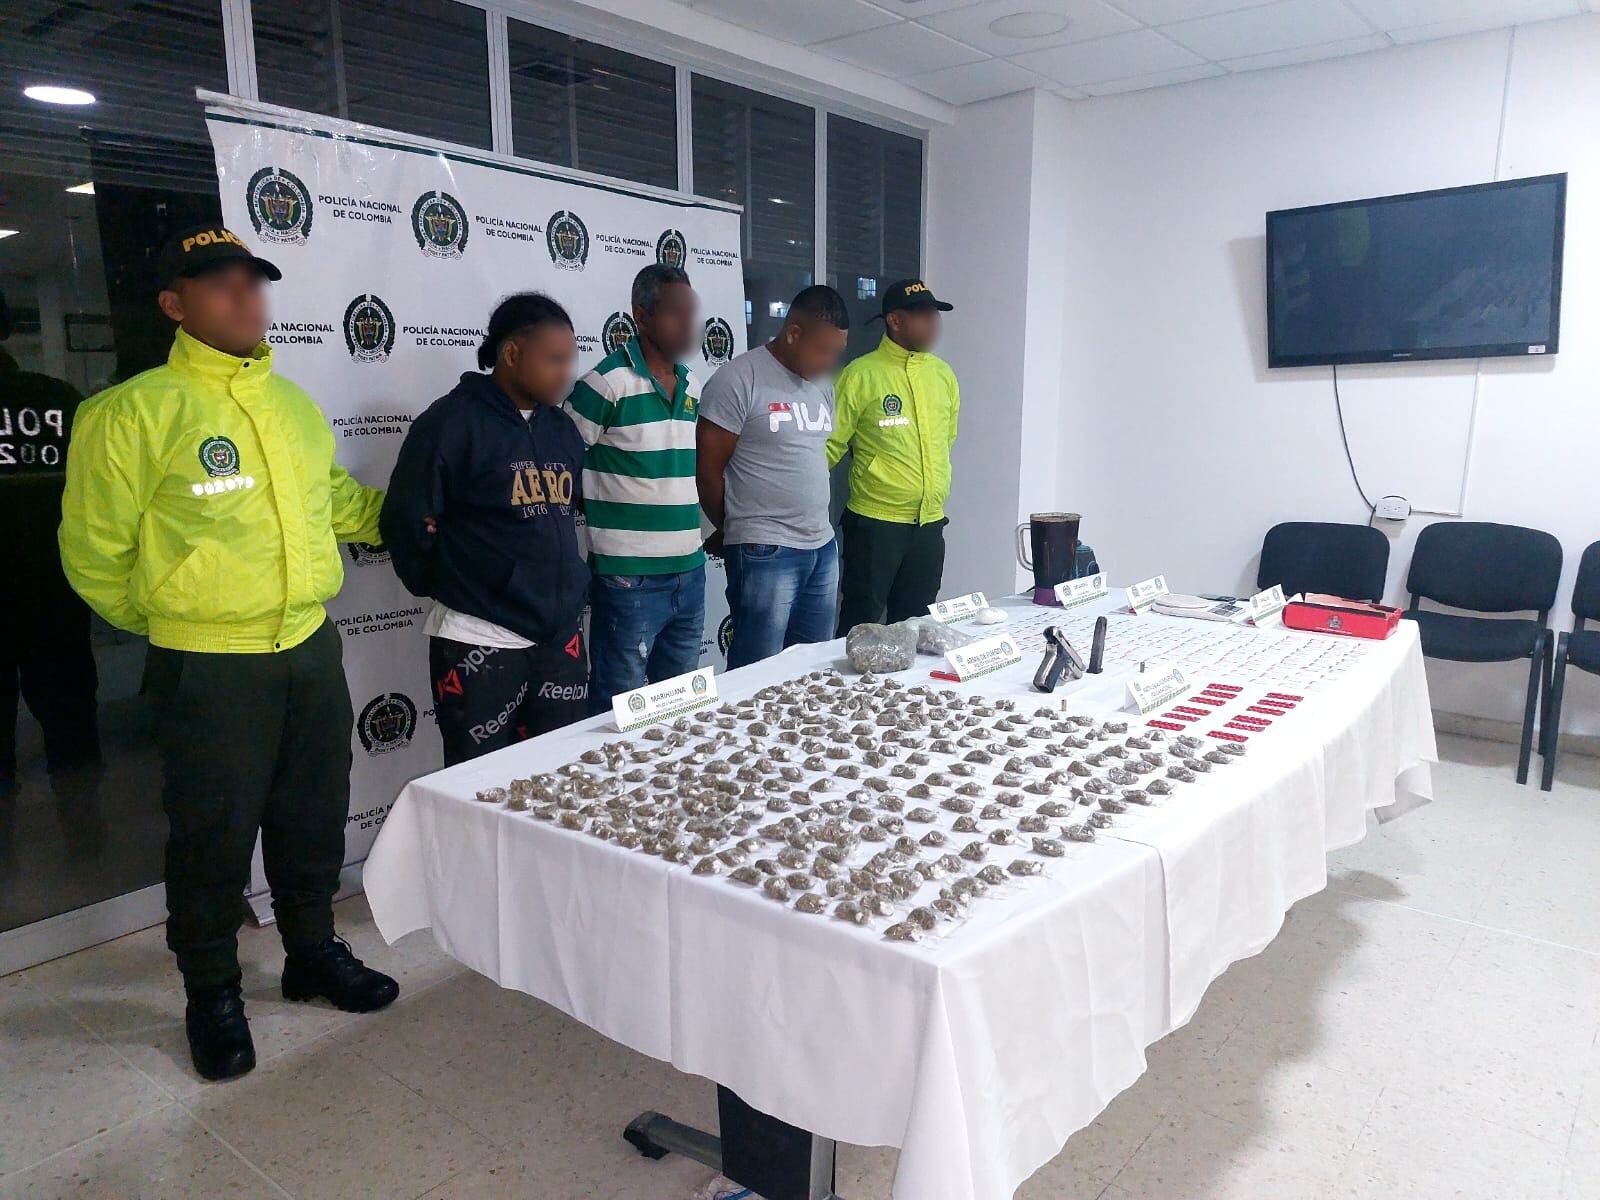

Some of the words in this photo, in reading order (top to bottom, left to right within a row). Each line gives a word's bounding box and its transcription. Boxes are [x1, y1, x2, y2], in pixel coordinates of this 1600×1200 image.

[318, 195, 357, 207] POLICÍA
[359, 199, 402, 213] NACIONAL
[333, 209, 346, 218] DE
[348, 211, 392, 224] COLOMBIA
[475, 215, 504, 227] POLICÍA
[505, 220, 543, 233] NACIONAL
[486, 228, 496, 236] DE
[497, 230, 534, 242] COLOMBIA
[622, 238, 653, 248] NACIONAL
[615, 246, 646, 257] COLOMBIA
[711, 249, 739, 259] NACIONAL
[705, 259, 733, 267] COLOMBIA
[281, 322, 335, 333] NACIONAL
[403, 325, 439, 335] POLICÍA
[441, 327, 485, 337] NACIONAL
[268, 335, 323, 344] COLOMBIA
[416, 338, 428, 346] DE
[430, 338, 475, 347] COLOMBIA
[576, 335, 600, 343] CIONAL
[333, 414, 362, 427] POLICÍA
[364, 415, 414, 424] NACIONAL
[767, 402, 833, 433] FILA
[344, 429, 353, 437] DE
[355, 426, 403, 436] COLOMBIA
[510, 468, 573, 506] AERO
[335, 613, 374, 628] POLICÍA
[376, 607, 424, 620] NACIONAL
[347, 628, 361, 636] DE
[363, 619, 413, 633] COLOMBIA
[650, 686, 687, 702] MARIHUANA
[469, 681, 528, 744] Reebok
[347, 806, 384, 823] POLICÍA
[360, 820, 373, 829] DE
